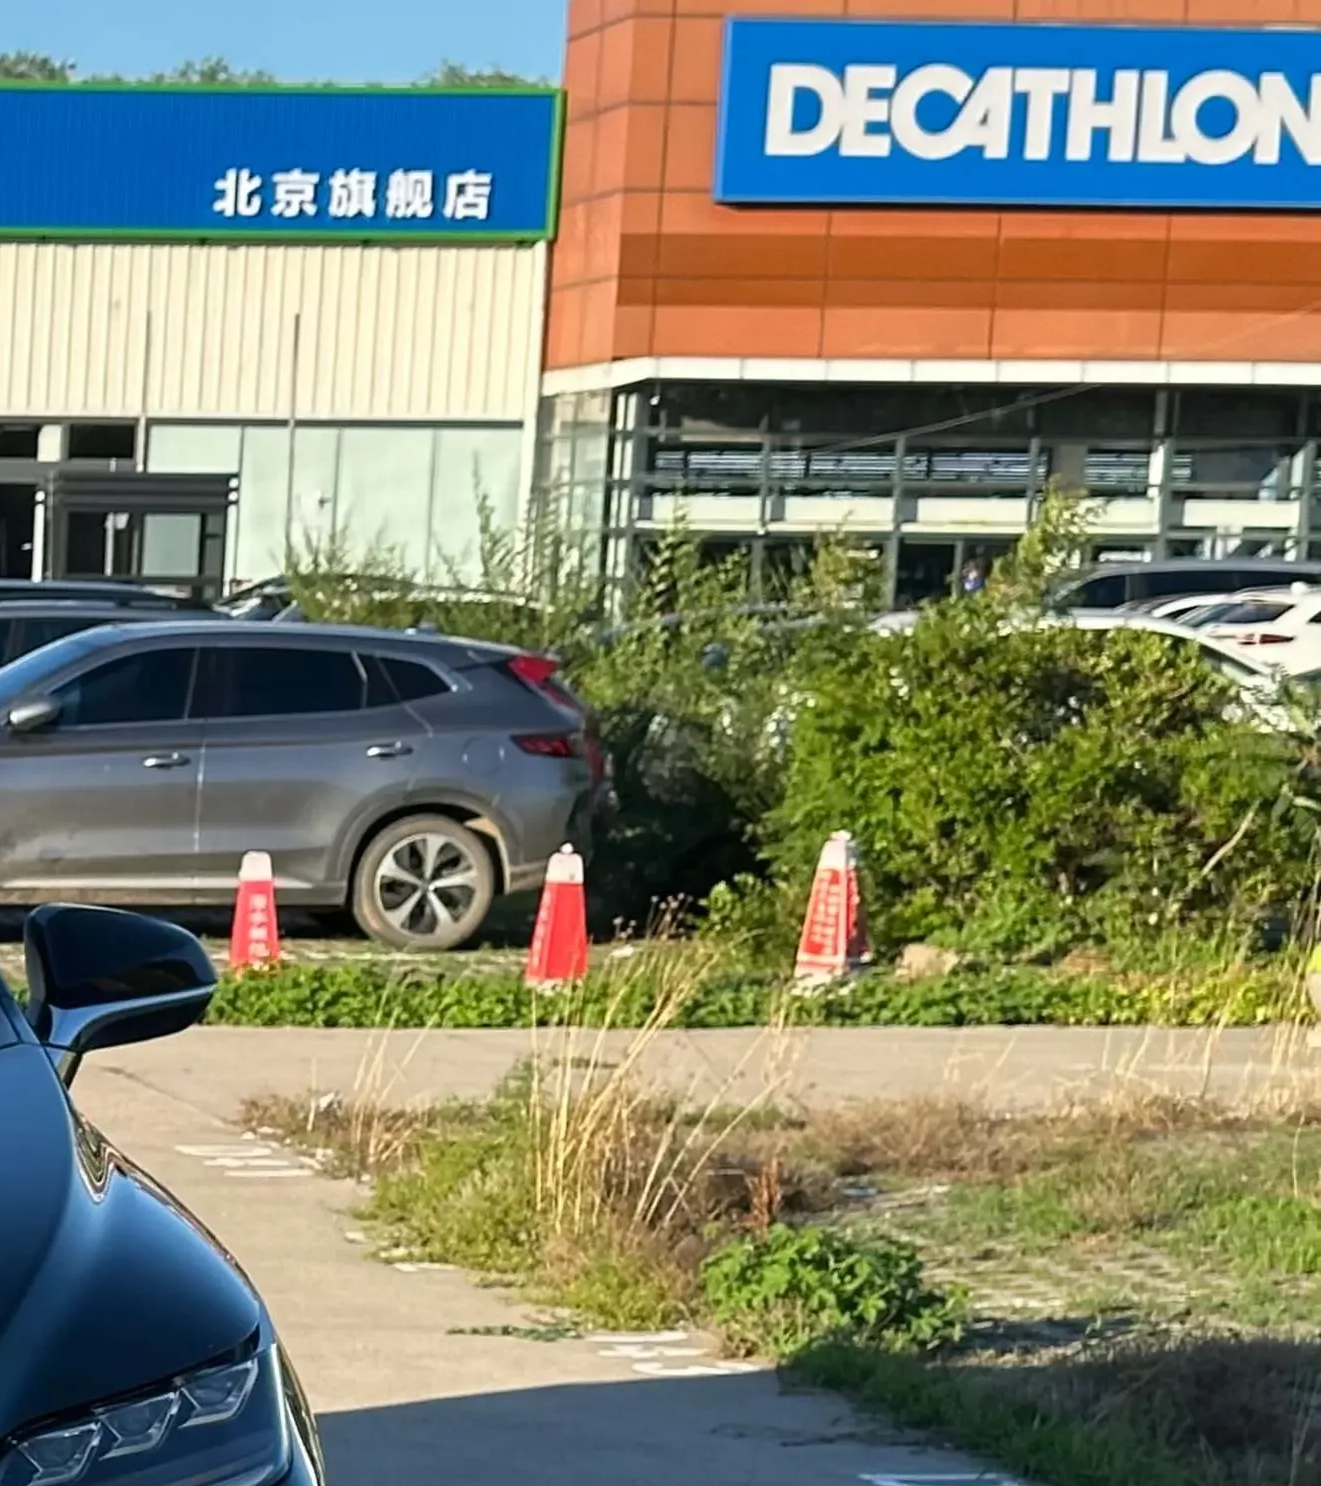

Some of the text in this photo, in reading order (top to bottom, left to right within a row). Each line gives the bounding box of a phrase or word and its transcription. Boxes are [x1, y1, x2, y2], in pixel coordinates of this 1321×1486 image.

[764, 62, 1321, 165] DECATHLON
[213, 167, 493, 220] 北京旗舰店
